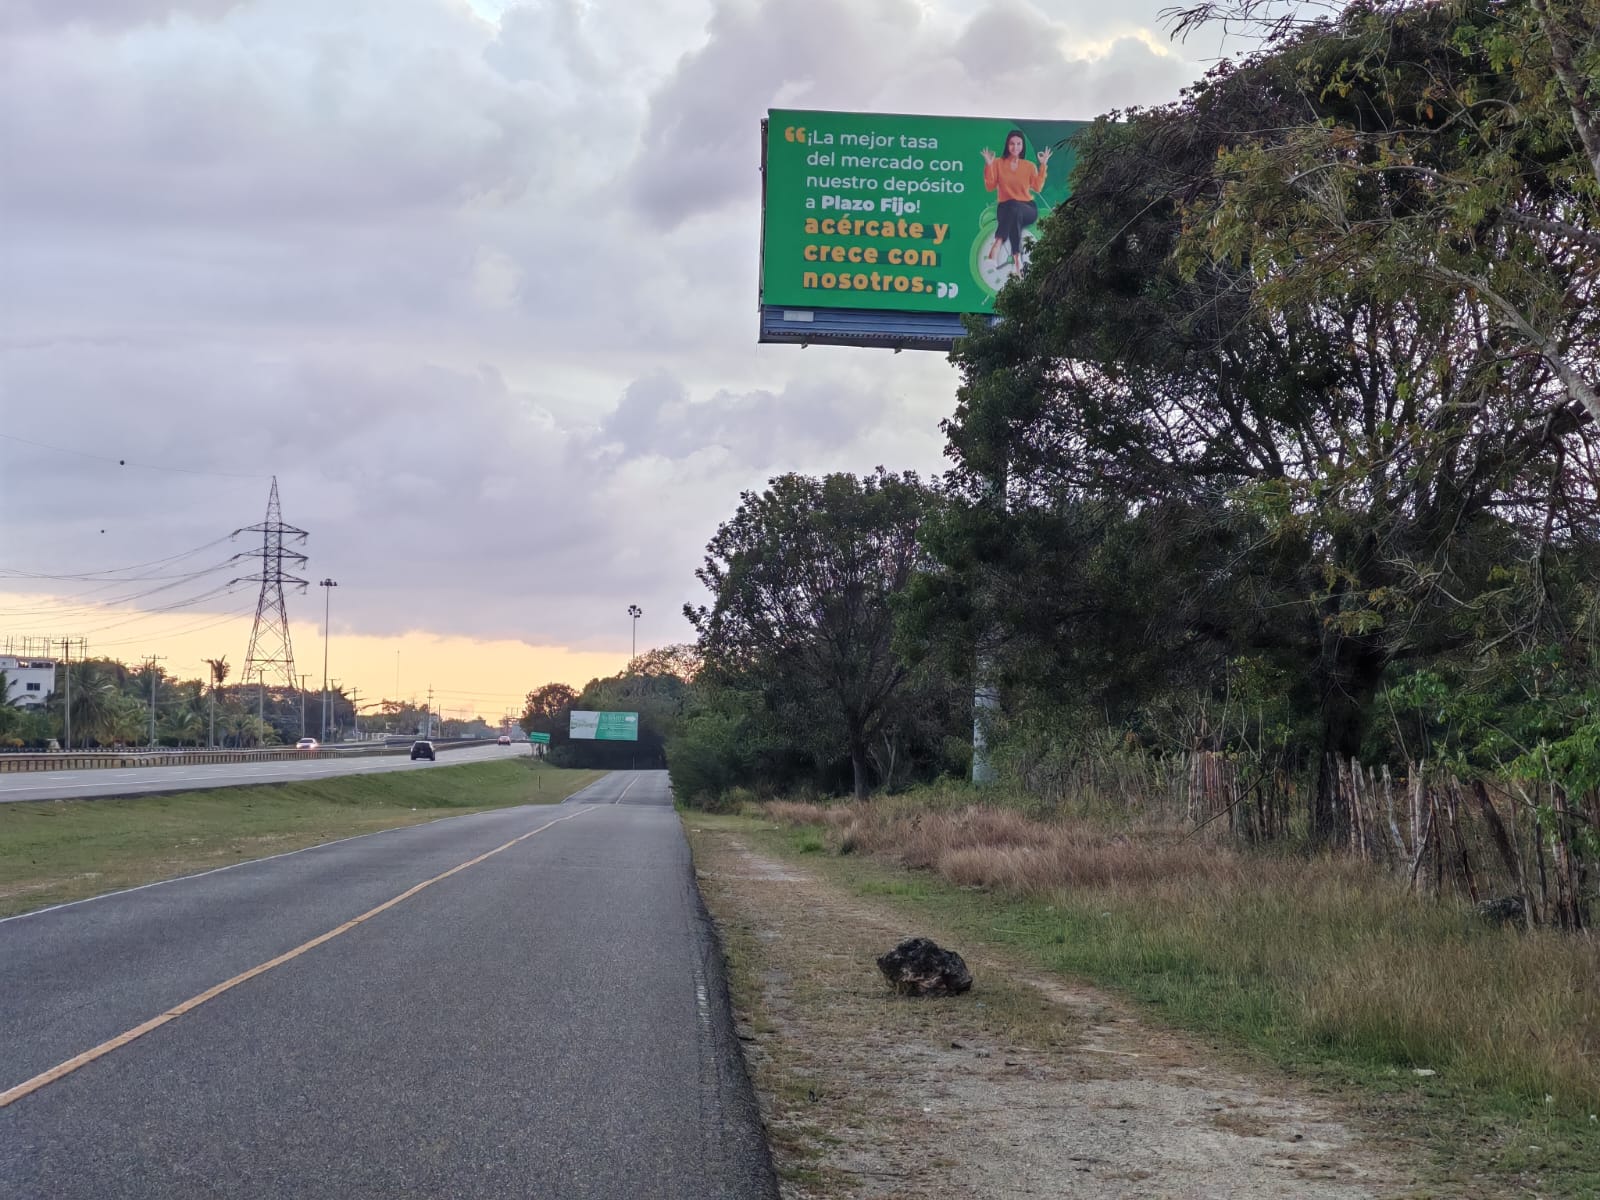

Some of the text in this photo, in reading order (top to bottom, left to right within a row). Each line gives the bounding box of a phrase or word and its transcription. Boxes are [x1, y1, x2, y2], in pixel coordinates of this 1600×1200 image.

[840, 132, 894, 150] mejor
[901, 136, 938, 148] tasa
[807, 152, 963, 171] del mercado con
[807, 175, 964, 194] nuestro depósito
[805, 196, 920, 216] a Plazo Fijo!
[804, 213, 949, 245] acércate y
[804, 245, 937, 266] crece con
